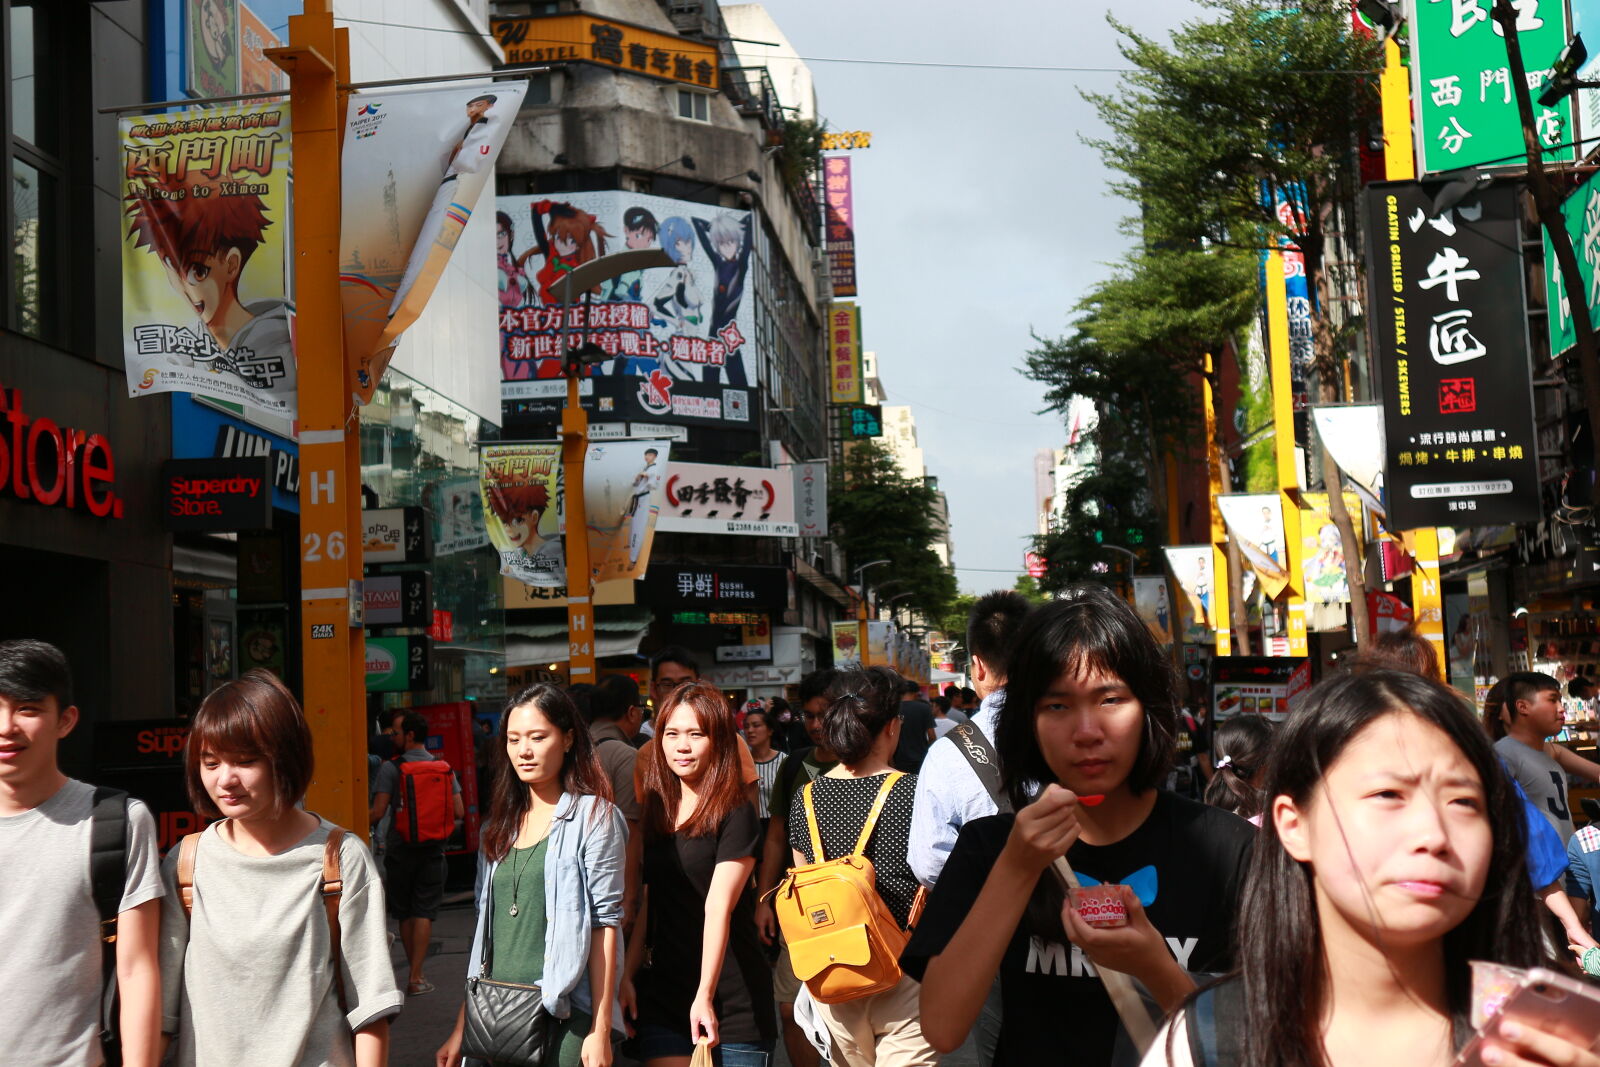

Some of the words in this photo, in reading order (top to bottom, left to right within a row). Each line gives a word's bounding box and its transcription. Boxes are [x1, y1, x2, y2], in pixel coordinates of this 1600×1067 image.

[509, 46, 578, 62] HOSTEL
[591, 23, 713, 85] 窩青年旅舍
[350, 119, 372, 128] TAIPEI
[372, 113, 387, 121] 2017
[124, 132, 283, 184] 西門町
[192, 183, 210, 196] to
[220, 182, 268, 196] Ximen
[1386, 195, 1401, 241] GRATIN
[1391, 244, 1404, 293] GRILLED
[500, 304, 649, 331] 本官方正版授權
[1394, 307, 1407, 345] STEAK
[1397, 360, 1411, 417] SKEWERS
[1420, 429, 1496, 445] 流行時尚餐廳
[170, 475, 261, 498] Superdry
[311, 470, 335, 504] H
[170, 498, 222, 516] Store.
[736, 523, 752, 531] 2388
[753, 524, 769, 532] 6611
[303, 531, 345, 562] 26
[720, 582, 744, 590] SUSHI
[720, 591, 755, 599] EXPRESS
[1422, 580, 1436, 597] H
[312, 625, 333, 634] 24K
[573, 615, 585, 631] H
[571, 643, 589, 656] 24
[1547, 771, 1570, 820] J
